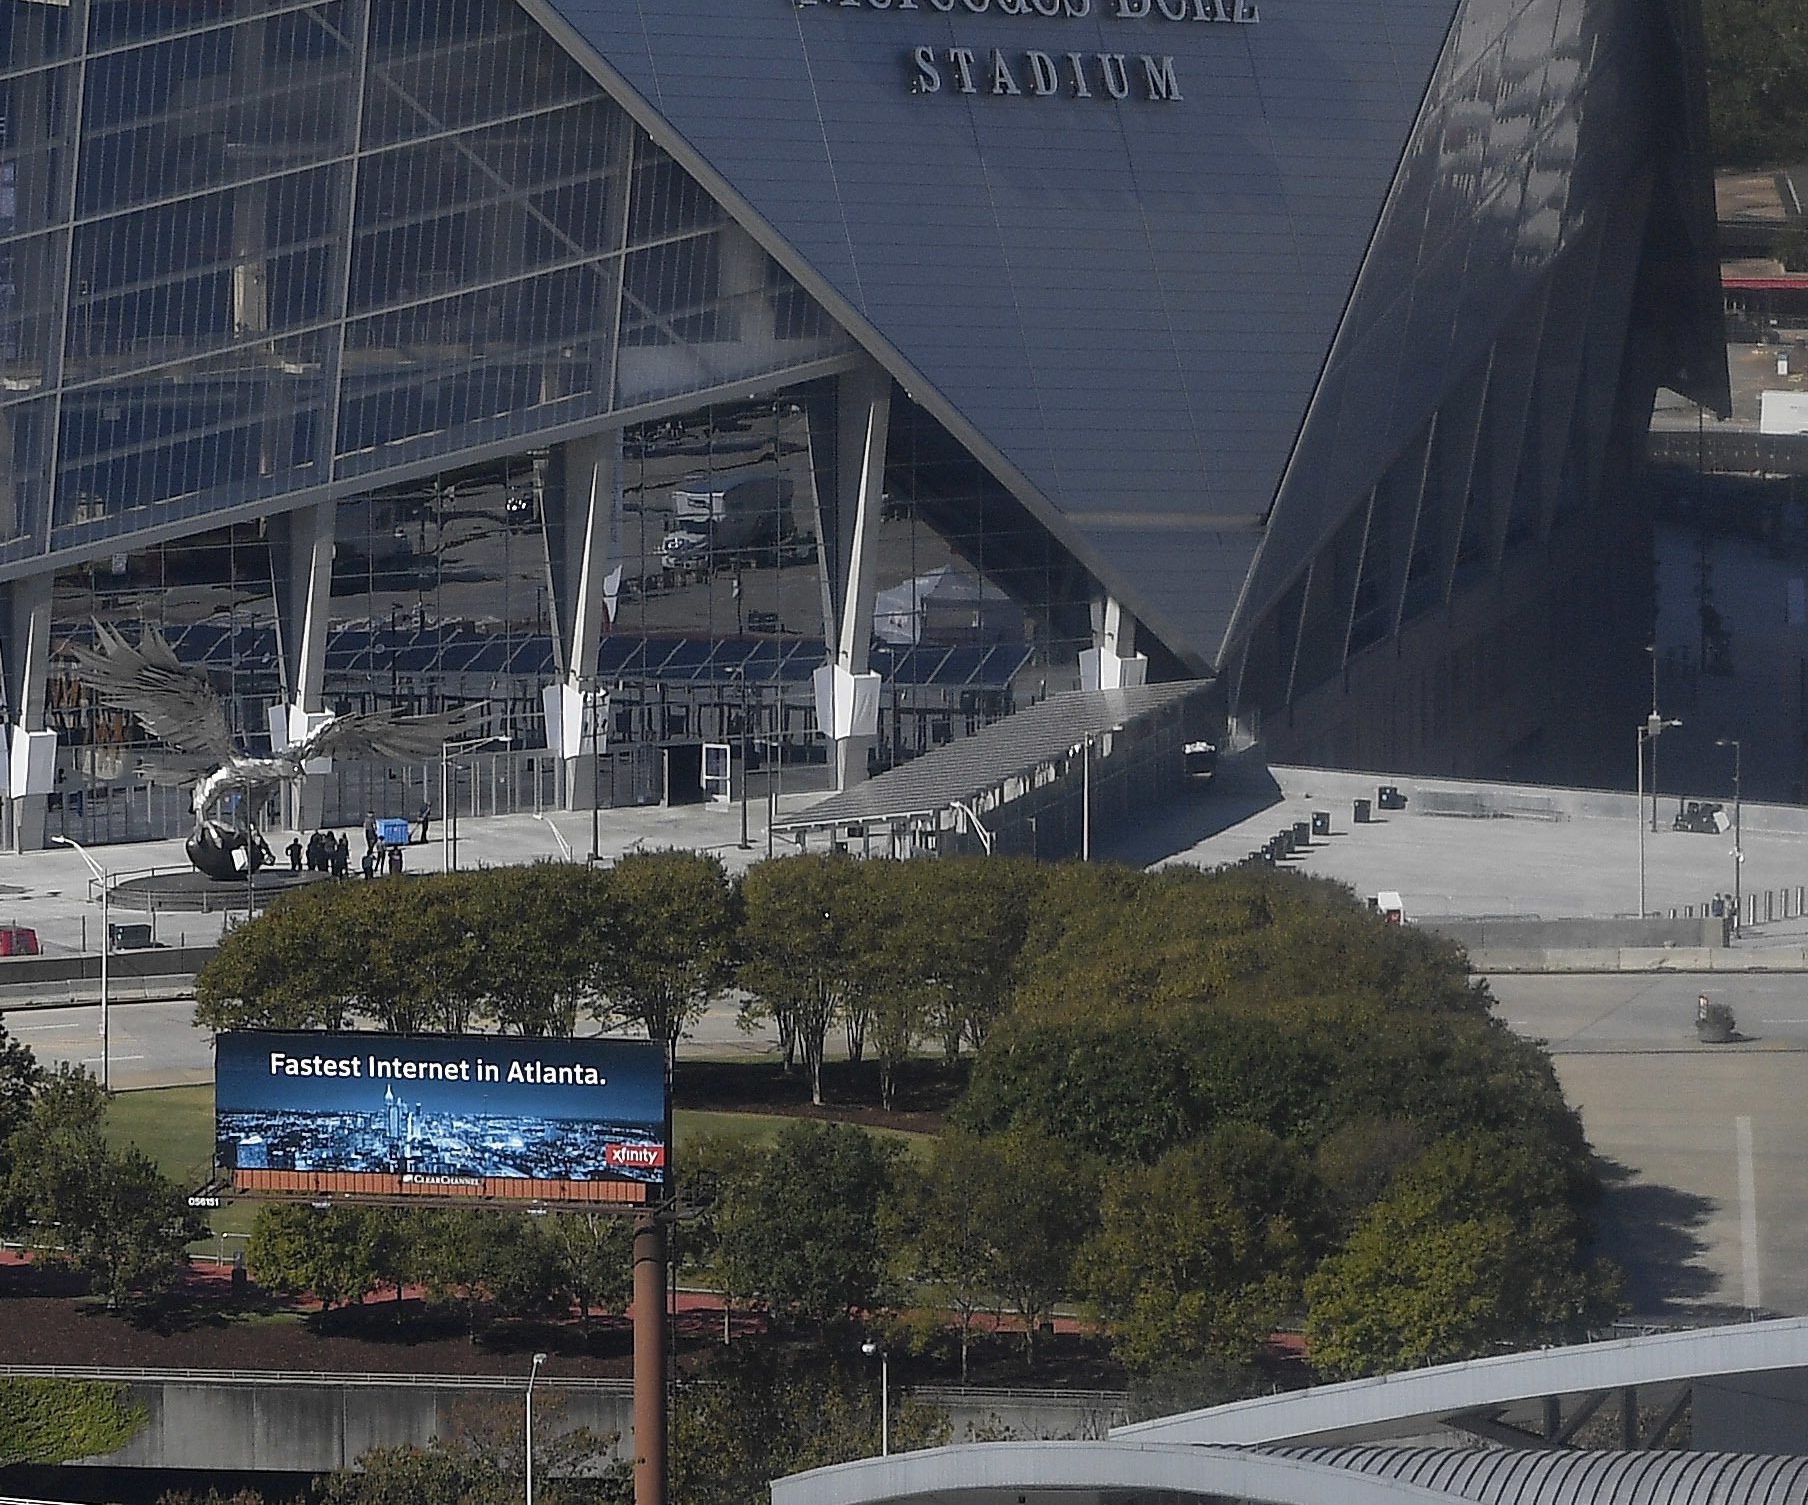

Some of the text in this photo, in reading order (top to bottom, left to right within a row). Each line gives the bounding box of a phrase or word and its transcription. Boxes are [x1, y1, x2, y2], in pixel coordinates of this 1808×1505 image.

[911, 45, 1184, 102] STADIUM
[270, 1052, 608, 1086] Fastest Internet in Atlanta.
[612, 1147, 658, 1165] xfinity
